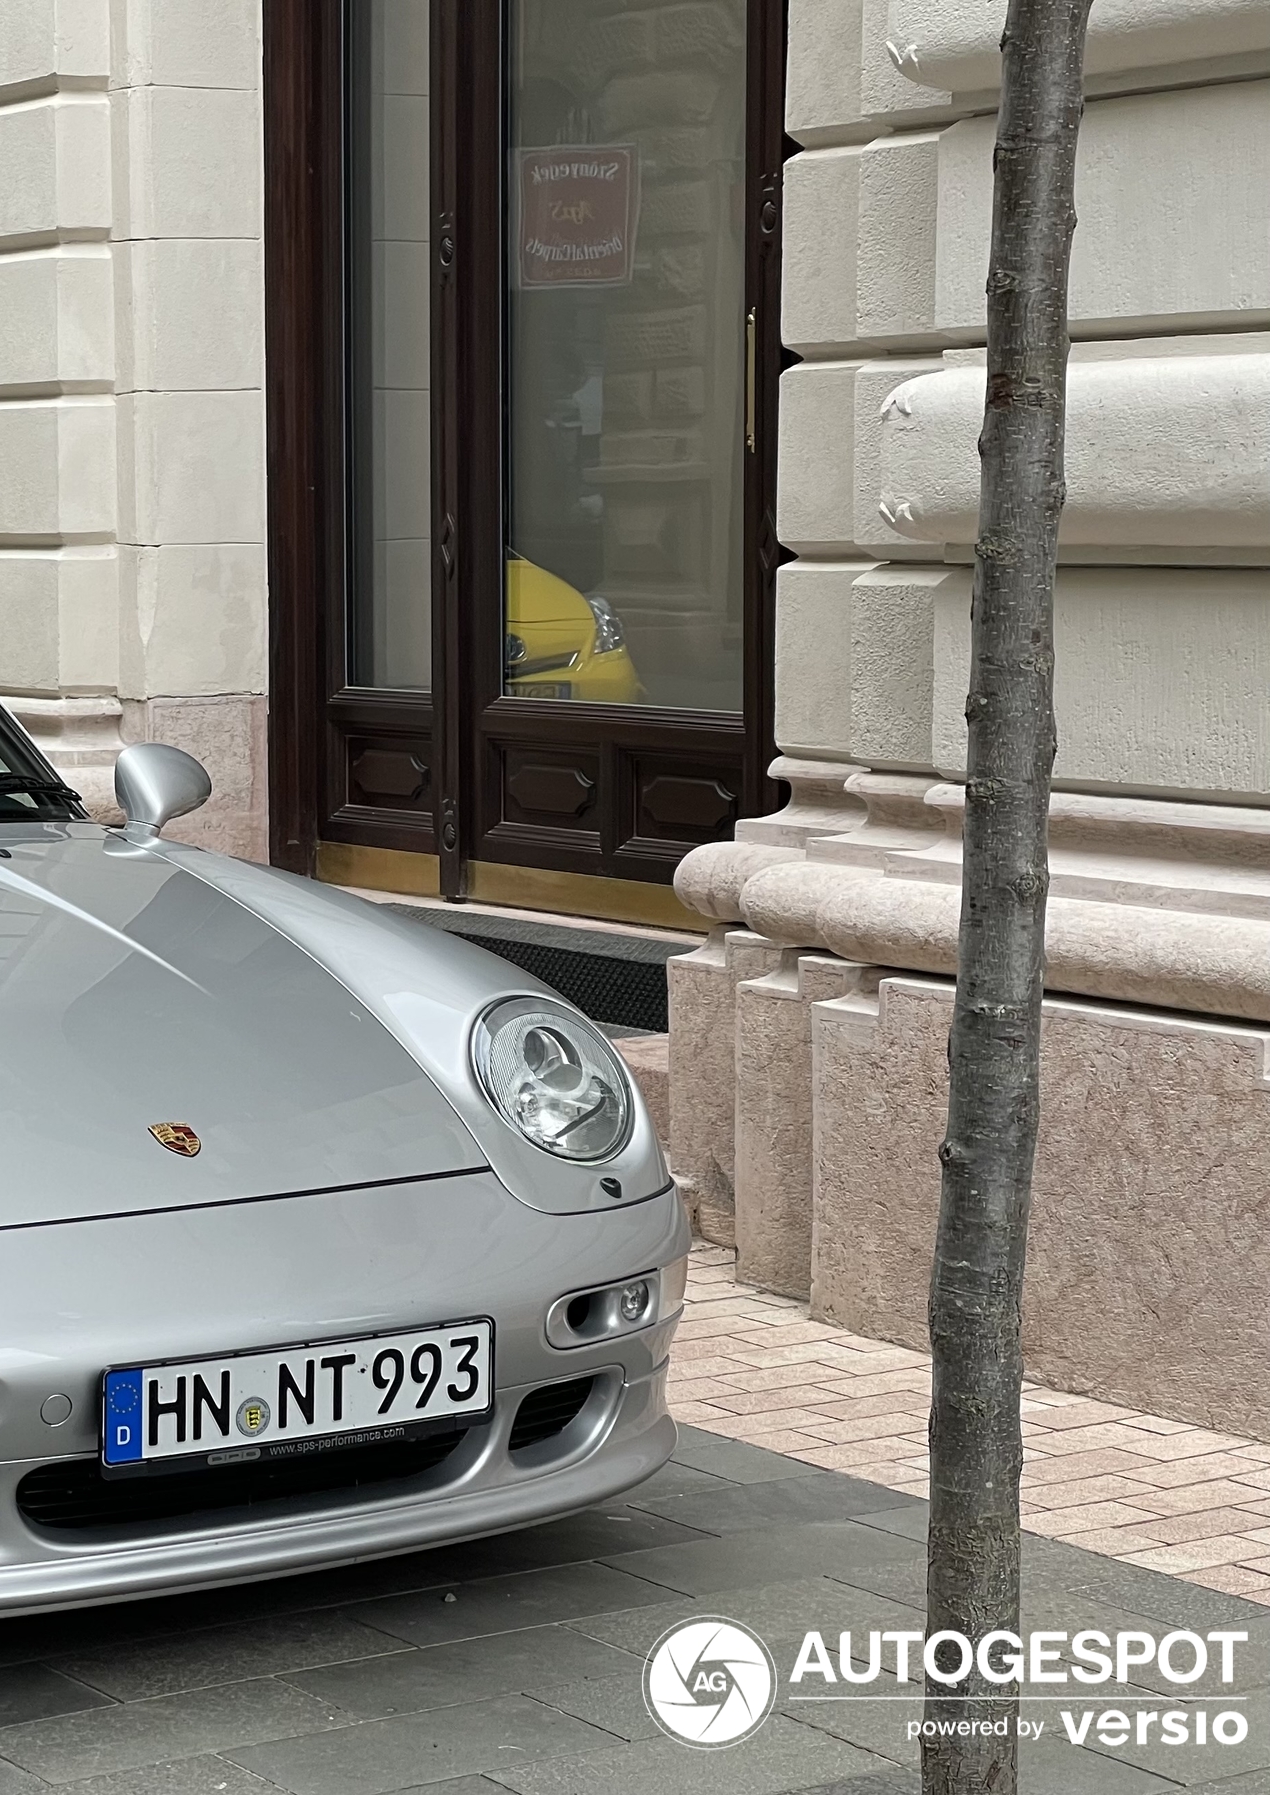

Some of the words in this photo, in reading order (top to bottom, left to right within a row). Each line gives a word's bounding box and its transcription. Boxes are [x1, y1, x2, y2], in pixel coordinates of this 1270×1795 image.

[148, 1369, 230, 1446] HN
[278, 1353, 356, 1429] NT
[372, 1335, 479, 1415] 993
[117, 1425, 131, 1446] D
[269, 1427, 405, 1456] www.sps-performance.com
